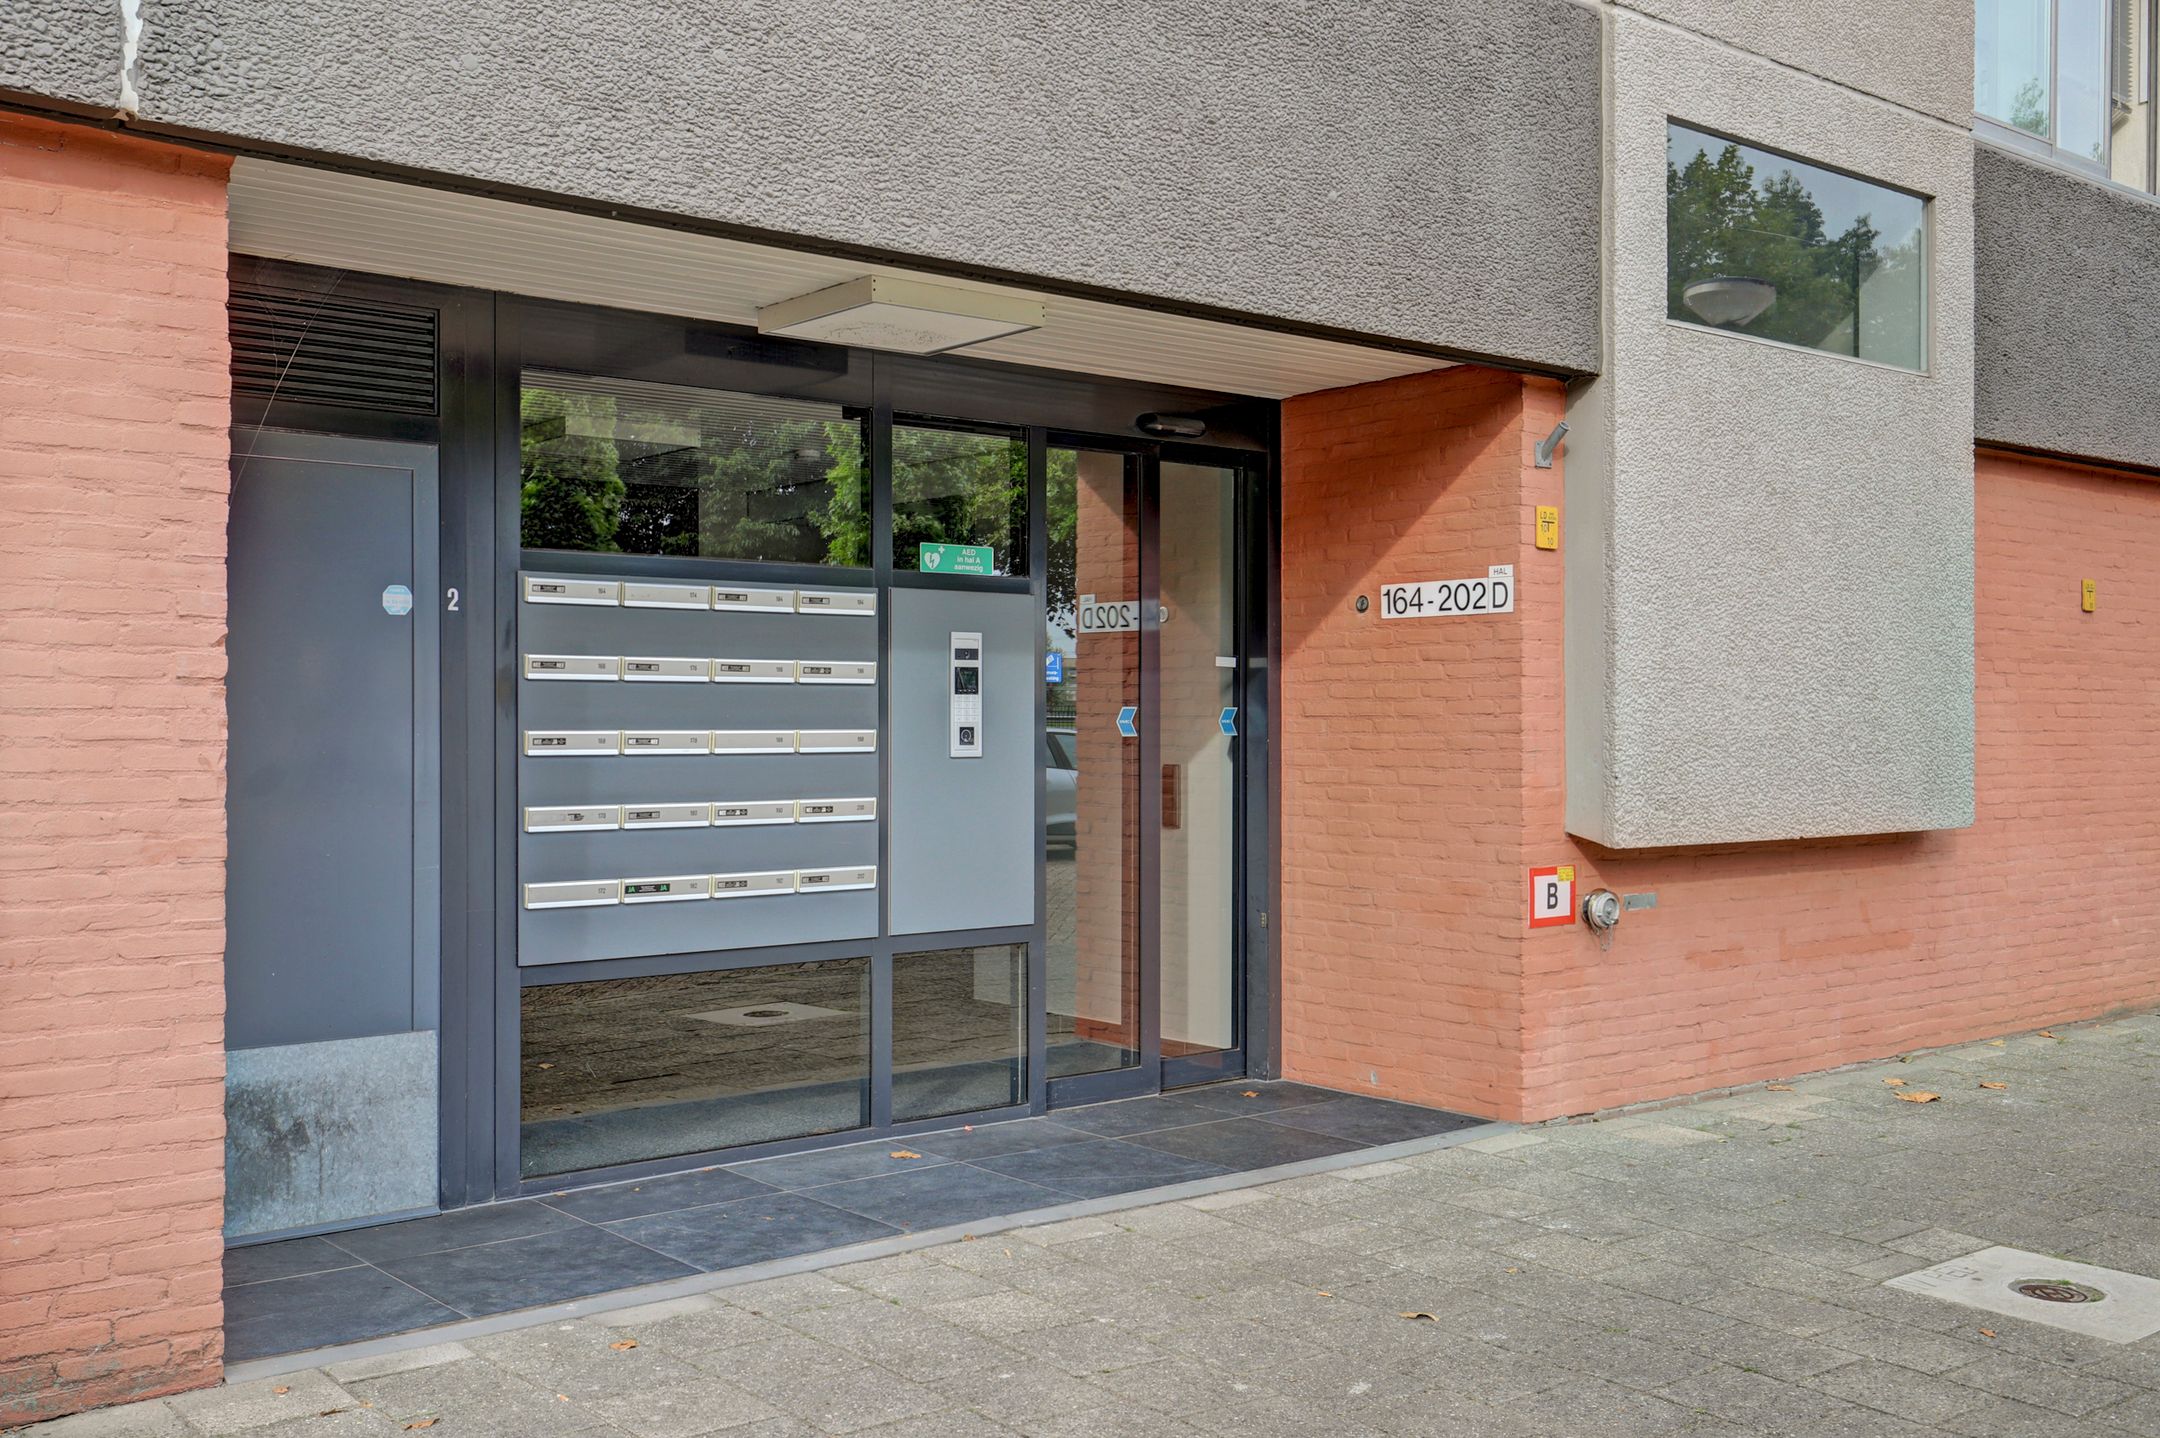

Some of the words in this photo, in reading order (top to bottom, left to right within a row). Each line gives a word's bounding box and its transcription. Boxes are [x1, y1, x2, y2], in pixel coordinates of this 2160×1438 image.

[961, 548, 977, 556] AED
[953, 564, 984, 573] aanwezig
[1493, 567, 1508, 576] HAL
[446, 587, 459, 612] 2
[1547, 882, 1558, 909] B
